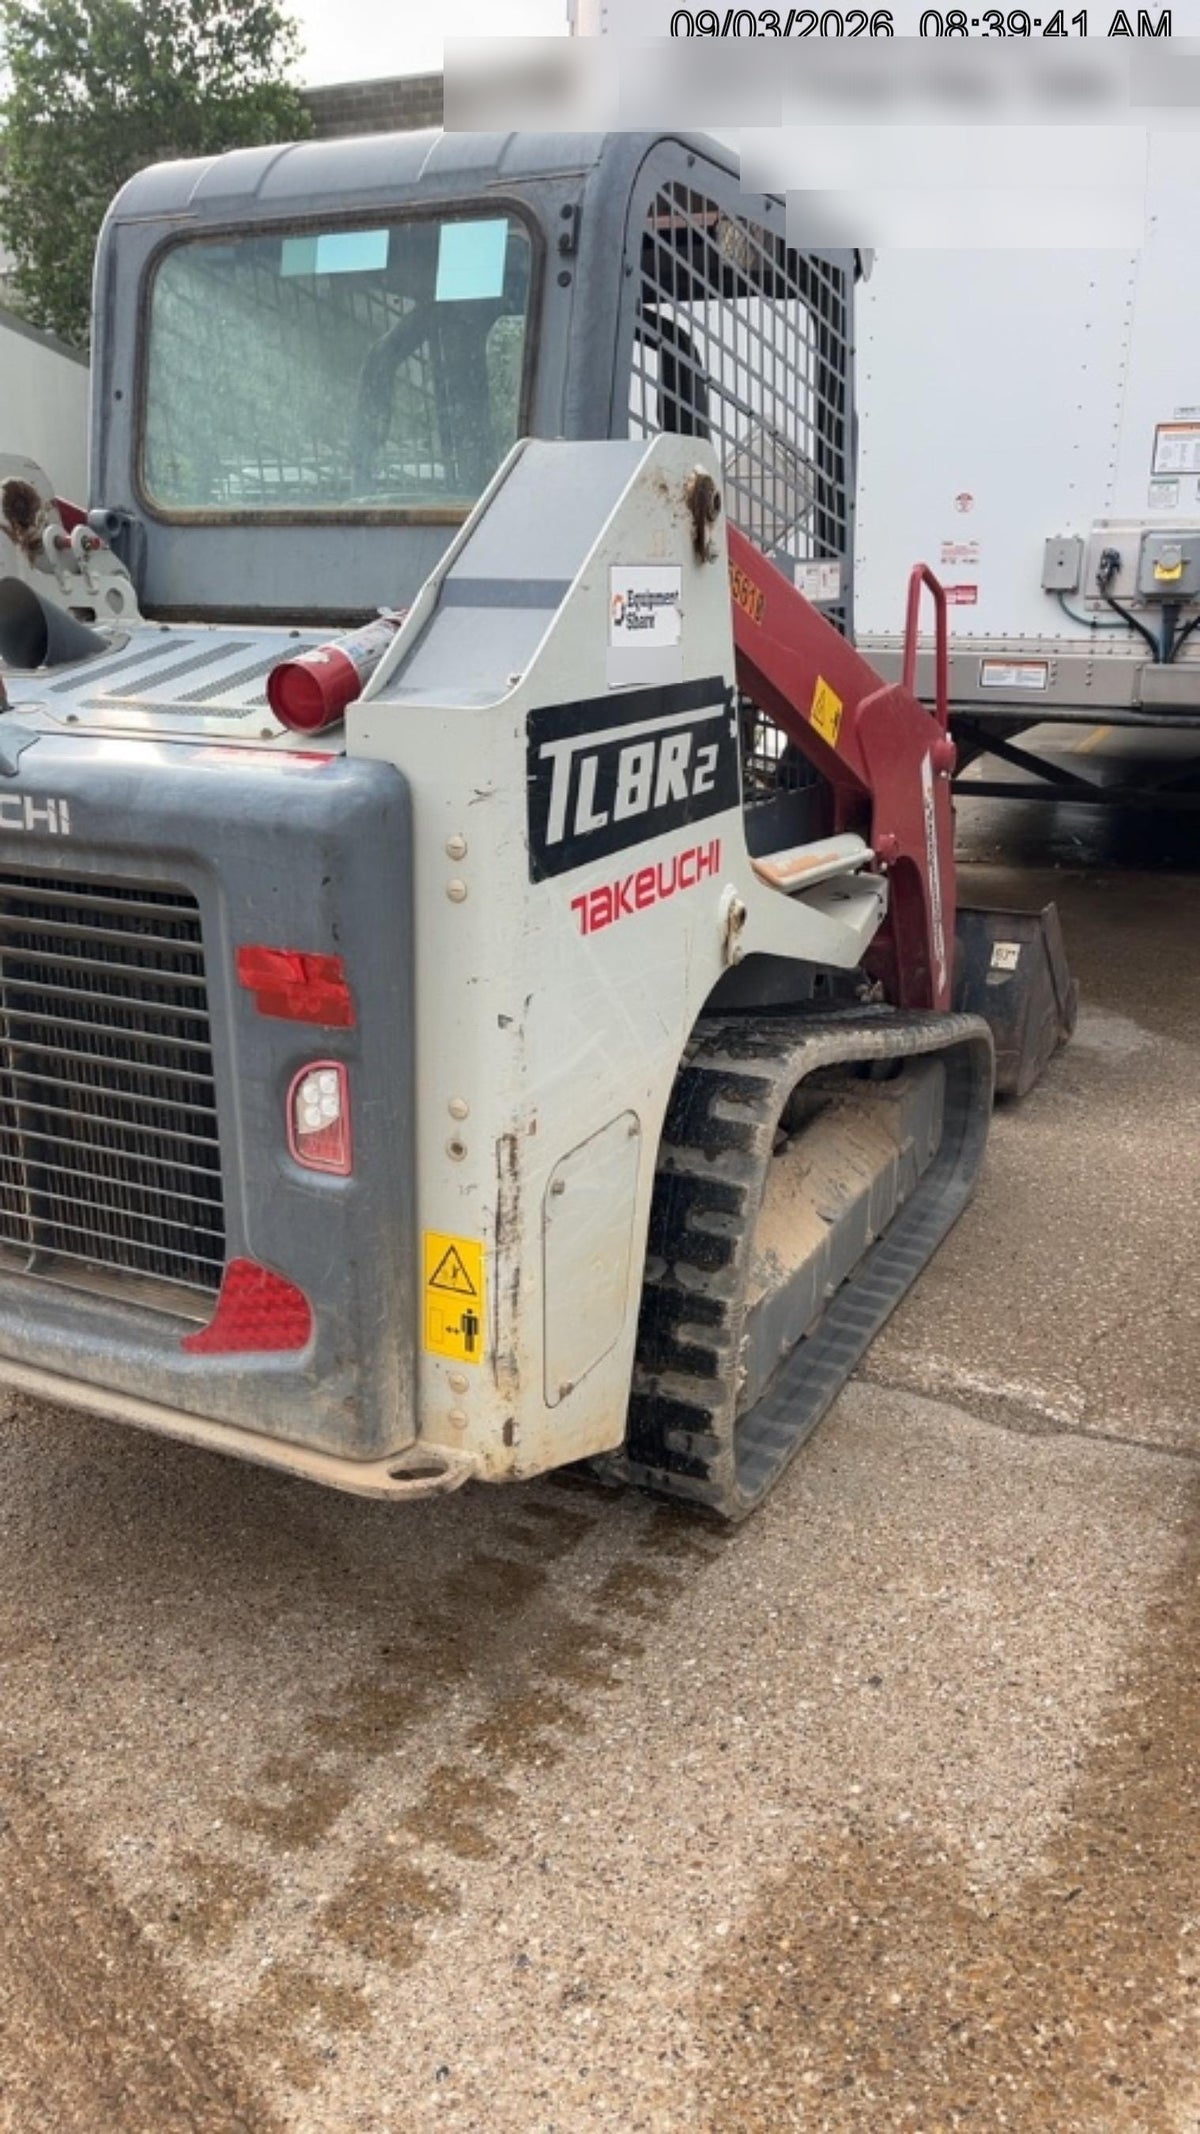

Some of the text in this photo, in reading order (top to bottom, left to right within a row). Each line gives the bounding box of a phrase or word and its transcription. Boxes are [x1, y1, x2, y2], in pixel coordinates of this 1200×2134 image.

[626, 612, 655, 630] Share
[627, 589, 679, 611] Equipment
[538, 703, 726, 846] TL8R2
[570, 838, 721, 936] TAKEUCHI
